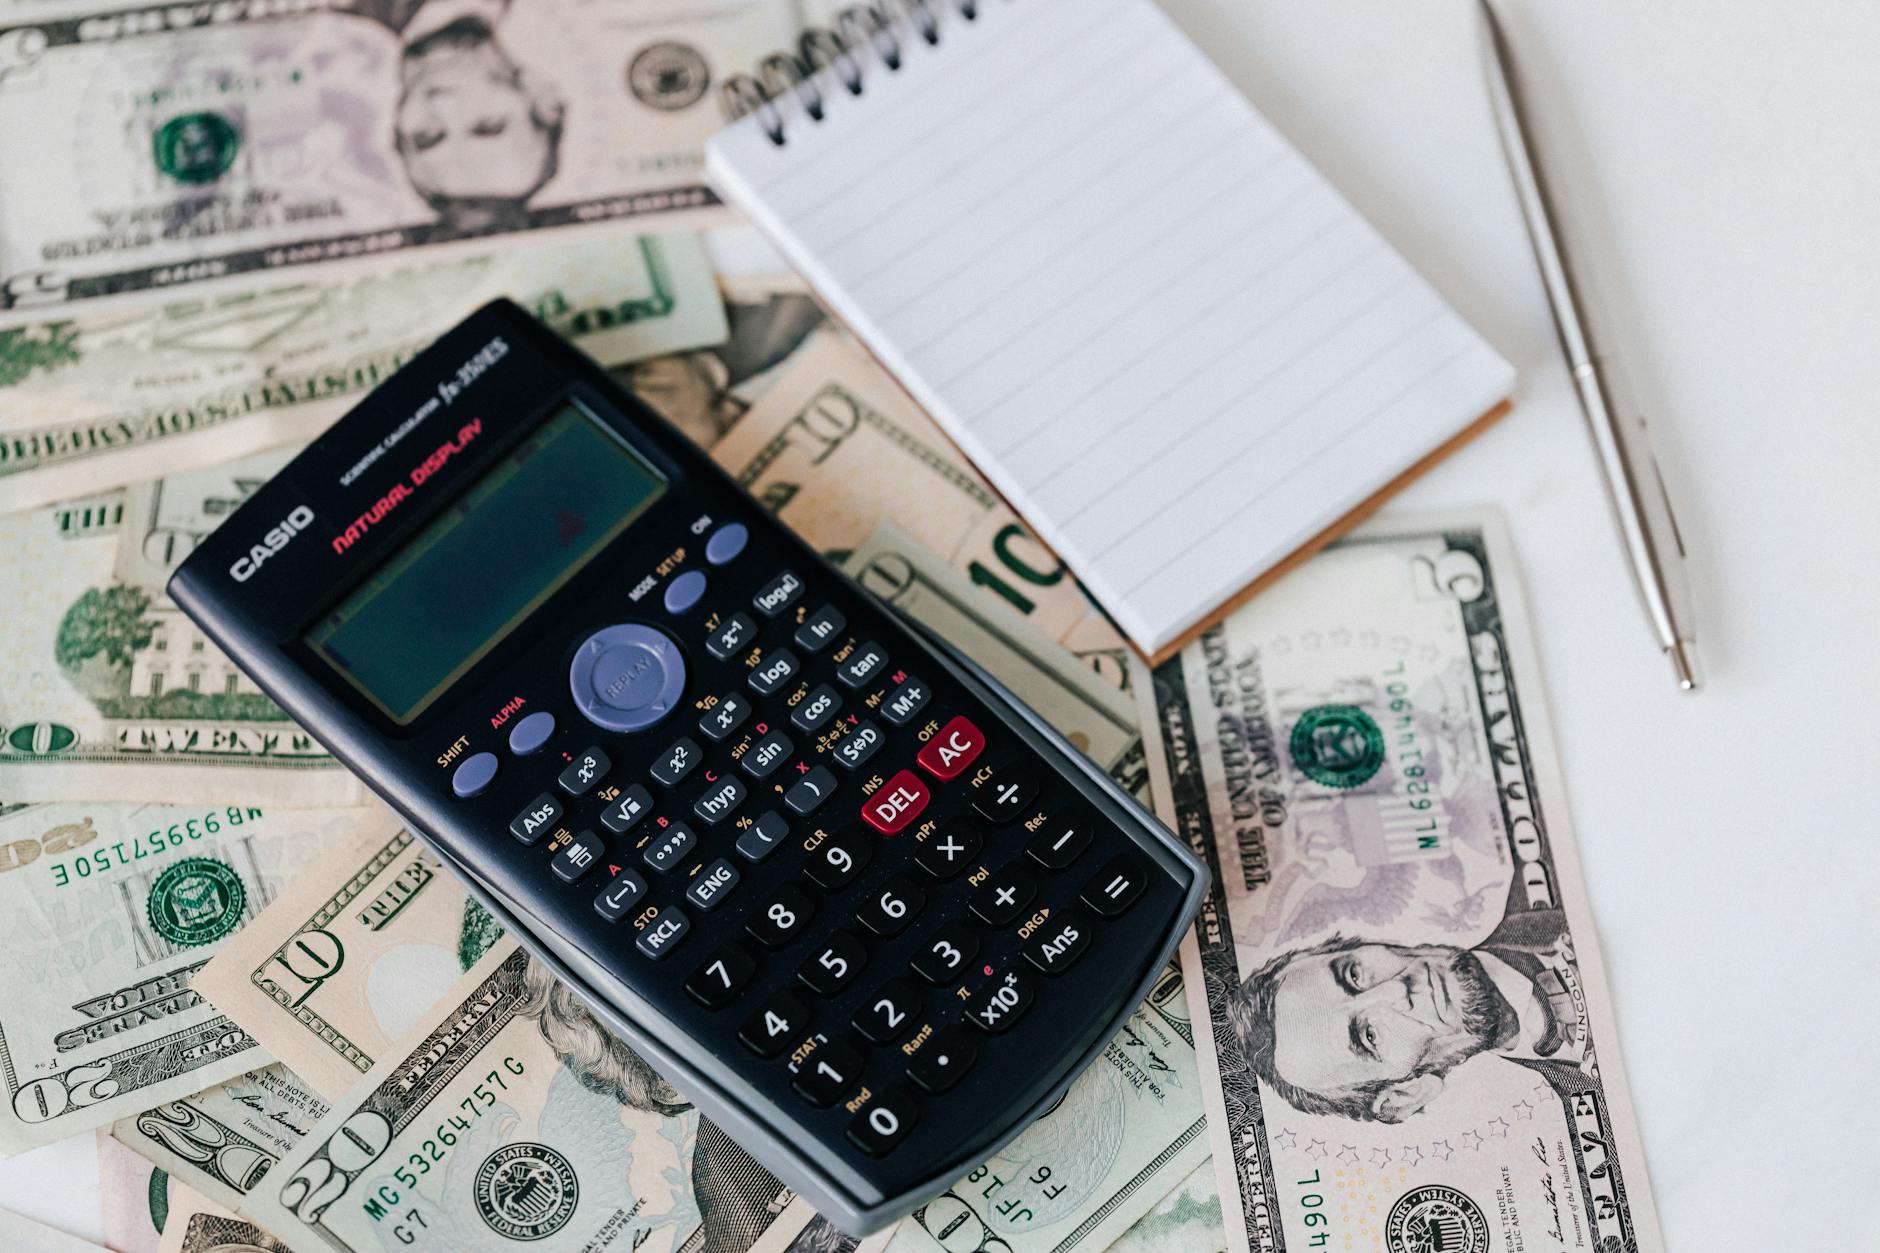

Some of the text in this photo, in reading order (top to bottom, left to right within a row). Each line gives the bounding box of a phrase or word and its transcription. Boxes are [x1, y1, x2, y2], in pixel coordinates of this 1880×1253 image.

[332, 484, 414, 555] NATURAL
[410, 417, 482, 485] DISPLAY
[230, 505, 315, 583] CASIO
[1413, 549, 1485, 602] 5
[811, 620, 833, 638] ln
[607, 655, 652, 699] REPLAY
[759, 659, 791, 685] log
[850, 652, 880, 677] tan
[891, 670, 907, 684] M
[490, 695, 527, 730] ALPHA
[805, 694, 832, 720] cos
[891, 687, 922, 716] M+
[756, 722, 768, 735] D
[848, 714, 859, 726] Y
[917, 720, 940, 743] OFF
[938, 731, 972, 767] AC
[1236, 645, 1288, 828] OF AMERICA
[437, 735, 471, 768] SHIFT
[757, 742, 782, 767] sin
[1383, 660, 1441, 850] ML 62814490 L
[705, 770, 718, 782] C
[796, 761, 810, 774] X
[970, 765, 994, 789] nCr
[1472, 630, 1554, 909] DOLLARS
[703, 785, 736, 814] hyp
[861, 774, 884, 796] INS
[875, 787, 921, 823] DEL
[1216, 714, 1270, 892] THE UNITED
[523, 803, 555, 834] Abs
[657, 816, 669, 828] B
[736, 815, 753, 830] %
[915, 820, 937, 842] nPr
[1024, 812, 1048, 833] Rec
[75, 813, 221, 880] 93957150
[803, 829, 828, 852] CLR
[608, 864, 622, 877] A
[826, 846, 853, 873] 9
[51, 863, 69, 887] E
[696, 864, 733, 901] ENG
[968, 866, 990, 888] Pol
[633, 905, 659, 931] STO
[767, 903, 796, 929] 8
[880, 891, 907, 918] 6
[647, 919, 682, 949] RCL
[1040, 925, 1079, 963] Ans
[272, 929, 345, 1009] 10
[819, 949, 848, 978] 5
[932, 941, 962, 968] 3
[705, 960, 732, 988] 7
[983, 965, 994, 976] e
[957, 986, 971, 1001] π
[1561, 967, 1588, 1043] LINCOLN
[764, 1010, 790, 1037] 4
[873, 999, 905, 1028] 2
[180, 1028, 247, 1063] OTE
[399, 987, 506, 1092] FEDERAL
[902, 1023, 933, 1056] Ran#
[1145, 1020, 1172, 1048] Treasurer
[791, 1036, 819, 1065] STAT
[817, 1061, 844, 1084] 1
[1104, 1050, 1143, 1090] THIS NOTE
[1136, 1067, 1150, 1083] ALL
[12, 1057, 121, 1124] 20
[245, 1071, 258, 1082] OR
[259, 1080, 275, 1093] ALL
[277, 1089, 306, 1111] DEBTS,
[264, 1071, 320, 1108] THIS NOTE IS
[846, 1087, 872, 1114] Rnd
[1149, 1082, 1166, 1100] FOR
[243, 1118, 274, 1139] Treasurer
[274, 1137, 283, 1146] of
[868, 1107, 899, 1136] 0
[137, 1098, 275, 1195] 20
[362, 1056, 525, 1223] MG 53264757 G
[279, 1110, 394, 1226] 20
[478, 1146, 534, 1203] UNITED STATES
[1029, 1165, 1067, 1200] F6
[1297, 1169, 1320, 1186] L
[1560, 1164, 1572, 1190] United
[1569, 1089, 1630, 1247] FIVE
[487, 1151, 574, 1238] FEDERAL RESERVE SYSTEM
[1419, 1190, 1466, 1213] SYSTEM
[1501, 1165, 1525, 1253] BLIC AND PRIVATE
[1566, 1191, 1575, 1202] the
[1567, 1203, 1579, 1212] of
[595, 1208, 625, 1240] TENDER
[602, 1229, 618, 1247] AND
[617, 1197, 647, 1230] PRIVATE
[995, 1198, 1033, 1224] JF
[1390, 1202, 1413, 1239] STATES
[1496, 1188, 1515, 1253] EGAL TENDER
[393, 1208, 429, 1246] G7
[1571, 1213, 1584, 1249] Treasurer
